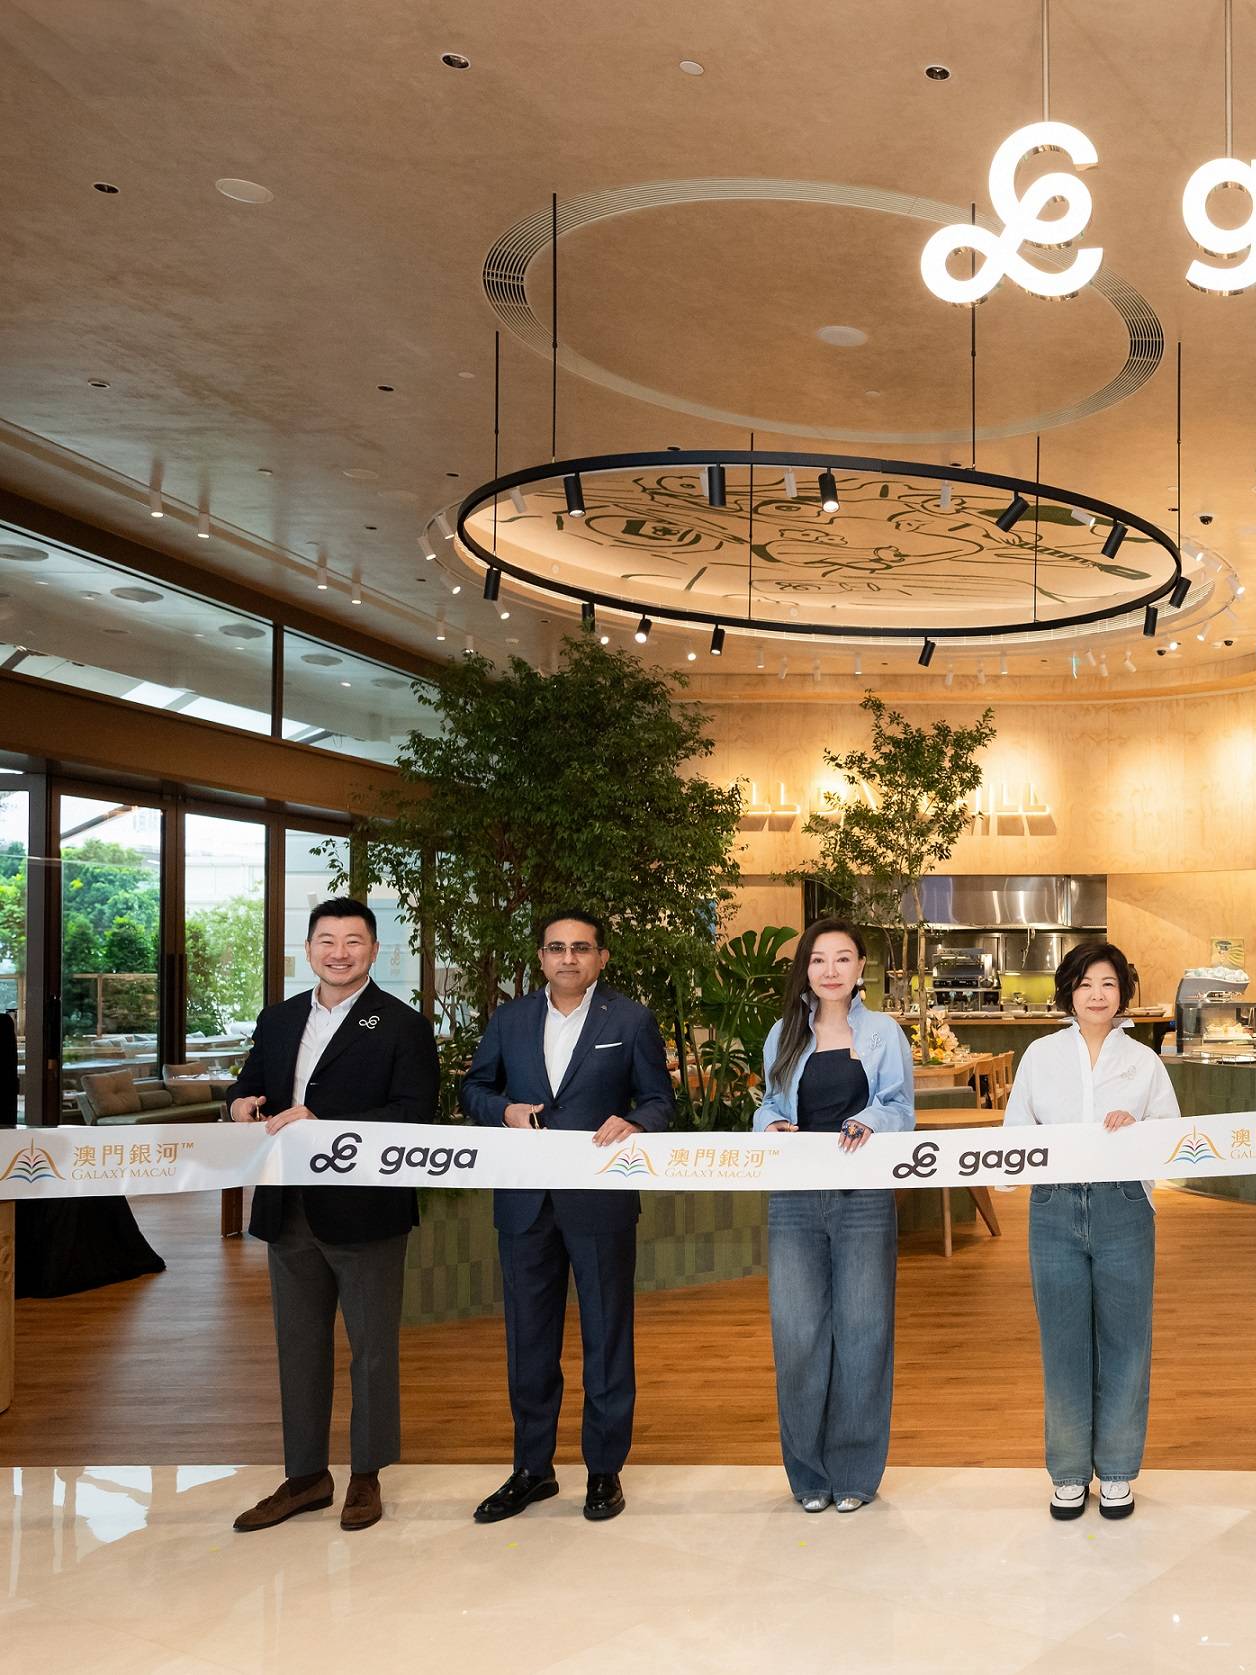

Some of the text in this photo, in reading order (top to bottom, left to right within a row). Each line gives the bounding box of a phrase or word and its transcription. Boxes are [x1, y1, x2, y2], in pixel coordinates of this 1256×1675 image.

[378, 1146, 479, 1176] gaga
[958, 1148, 1049, 1177] gaga
[71, 1167, 177, 1181] GALAXY MACAU
[664, 1168, 763, 1178] GALAXY MACAU
